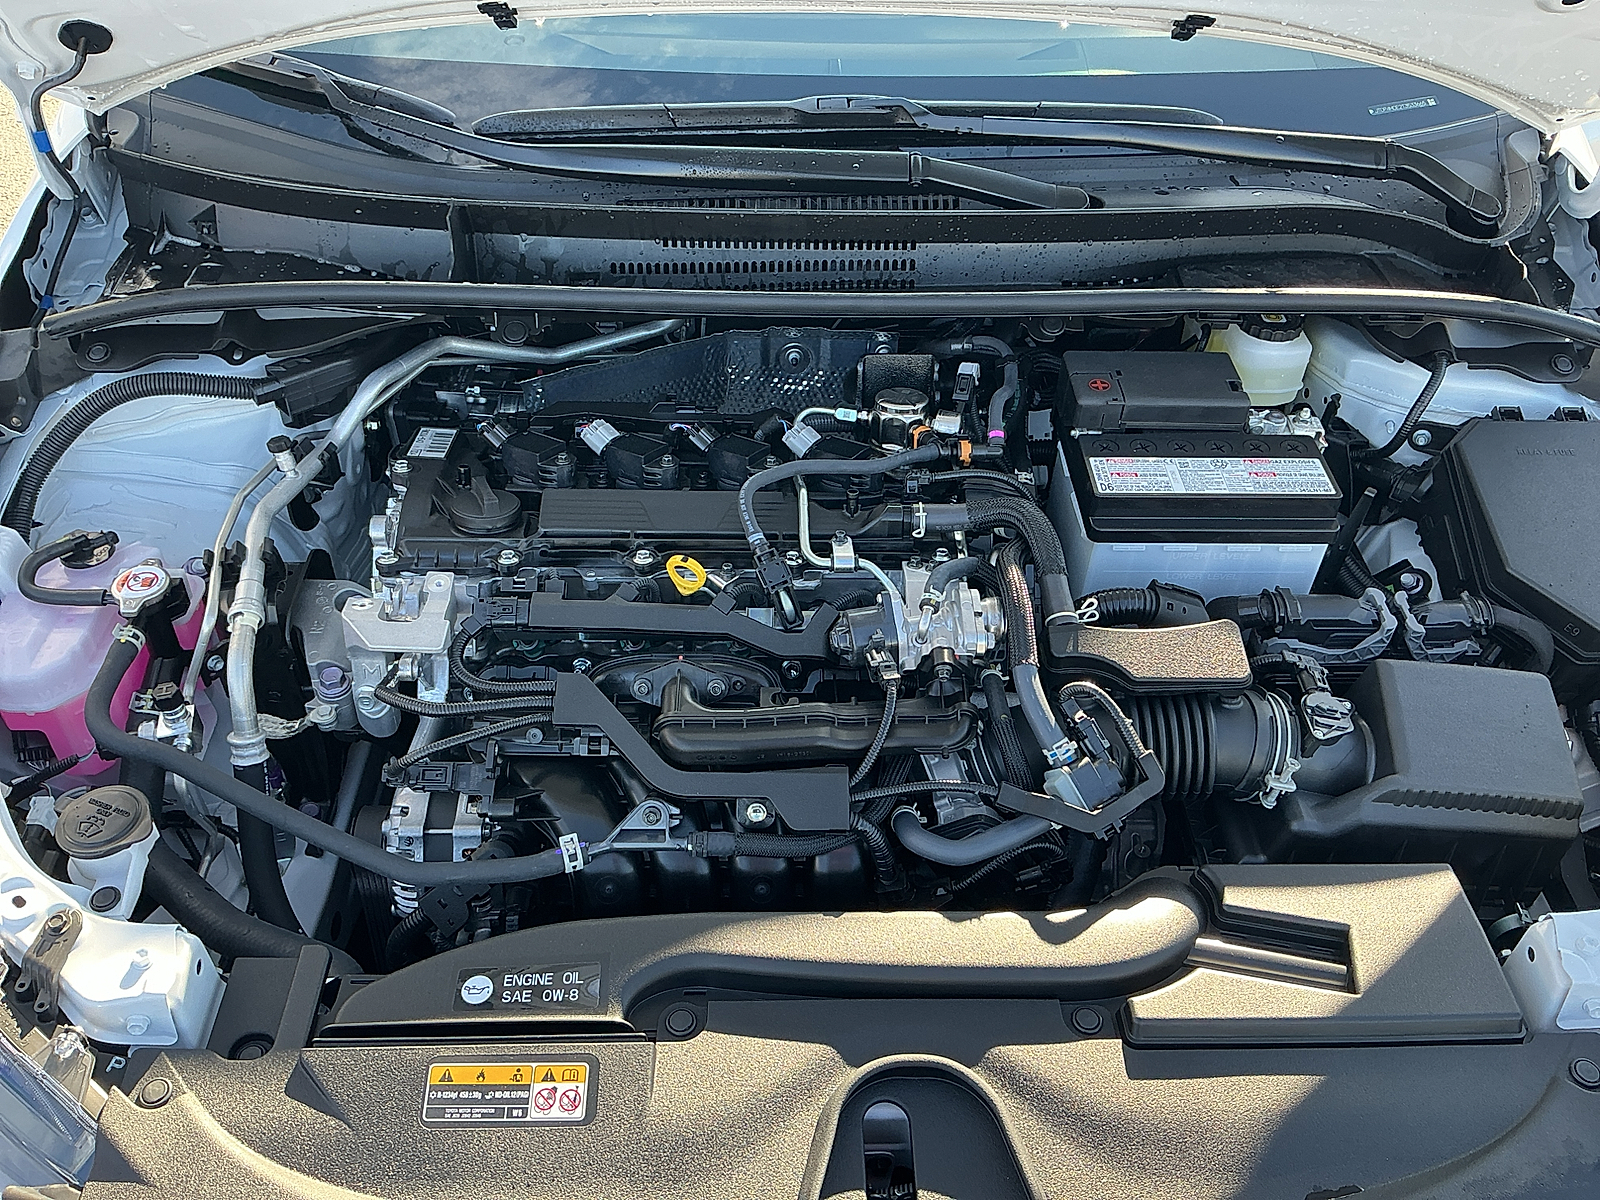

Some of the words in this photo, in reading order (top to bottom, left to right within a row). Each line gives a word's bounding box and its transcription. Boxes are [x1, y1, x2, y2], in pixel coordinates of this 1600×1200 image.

[1100, 482, 1115, 492] D6
[1172, 552, 1208, 560] UPPER
[1563, 622, 1580, 637] E9
[361, 663, 382, 679] M
[156, 684, 173, 697] H
[503, 973, 554, 987] ENGINE
[562, 971, 584, 985] OIL
[501, 990, 533, 1003] SAE
[542, 988, 579, 1002] 0W-8
[105, 1055, 126, 1073] P
